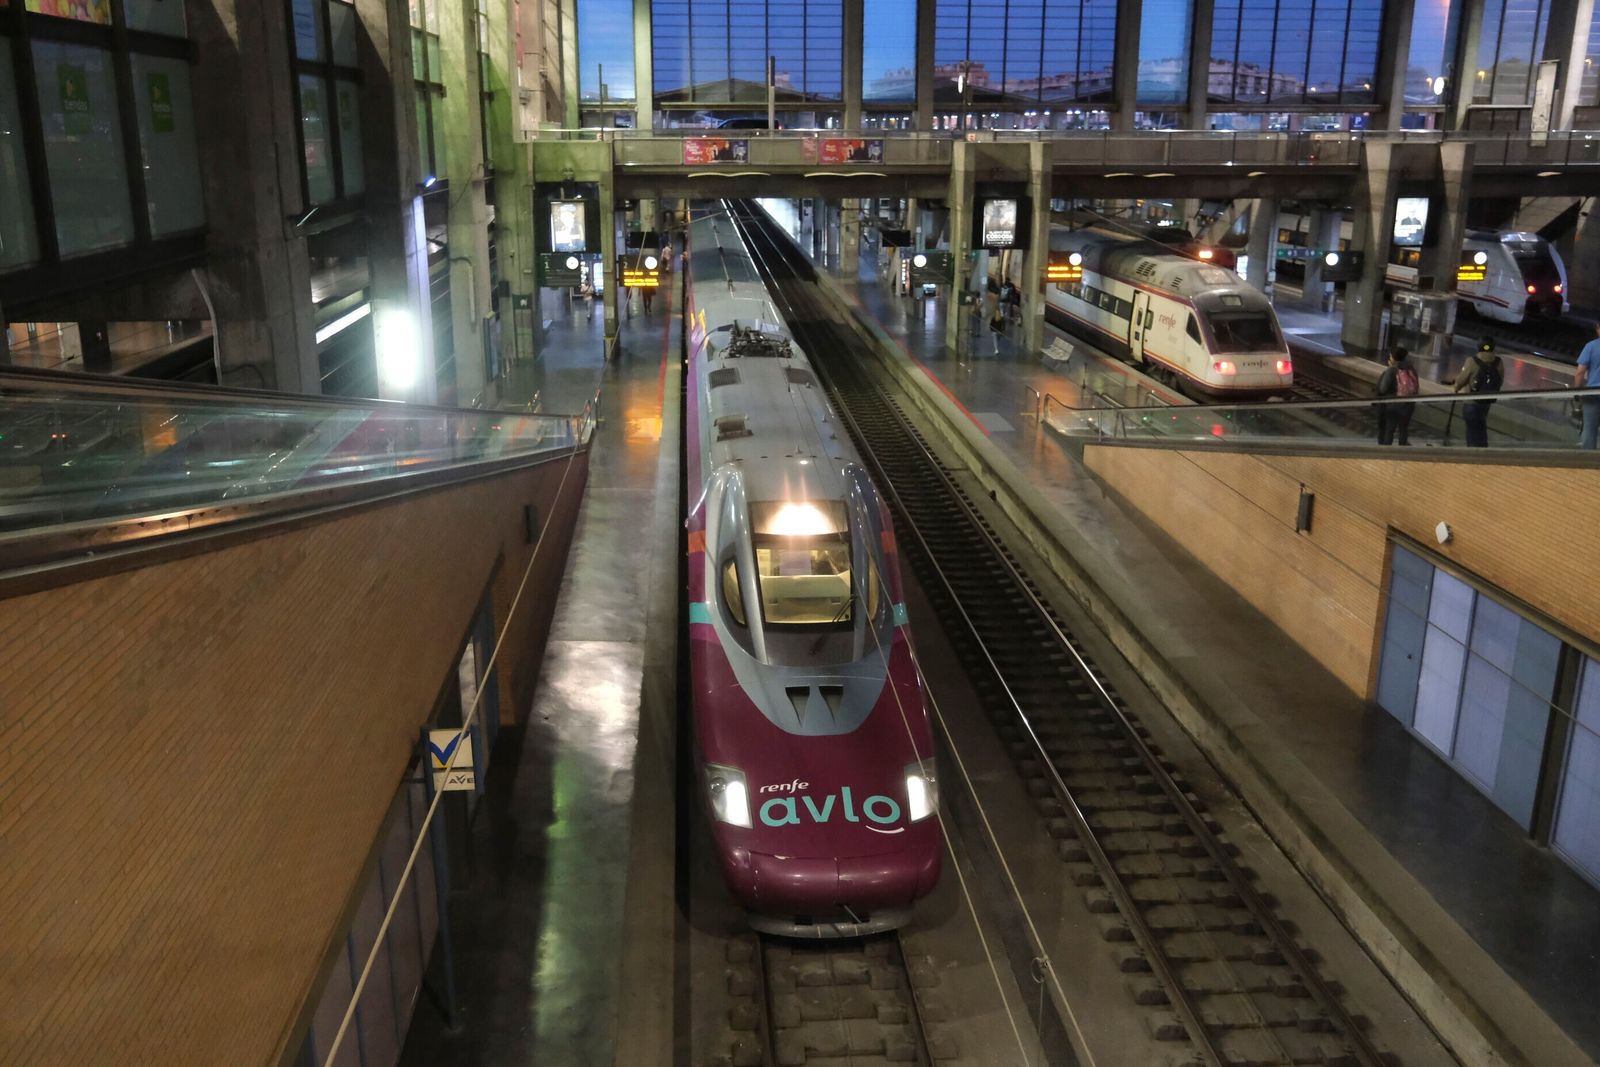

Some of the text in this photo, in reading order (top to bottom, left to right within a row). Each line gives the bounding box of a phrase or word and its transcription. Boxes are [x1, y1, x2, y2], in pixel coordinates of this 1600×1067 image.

[1355, 116, 1362, 124] P
[1158, 313, 1176, 332] renfe
[448, 774, 475, 784] AVE
[759, 778, 809, 794] renfe
[759, 786, 901, 827] avlo
